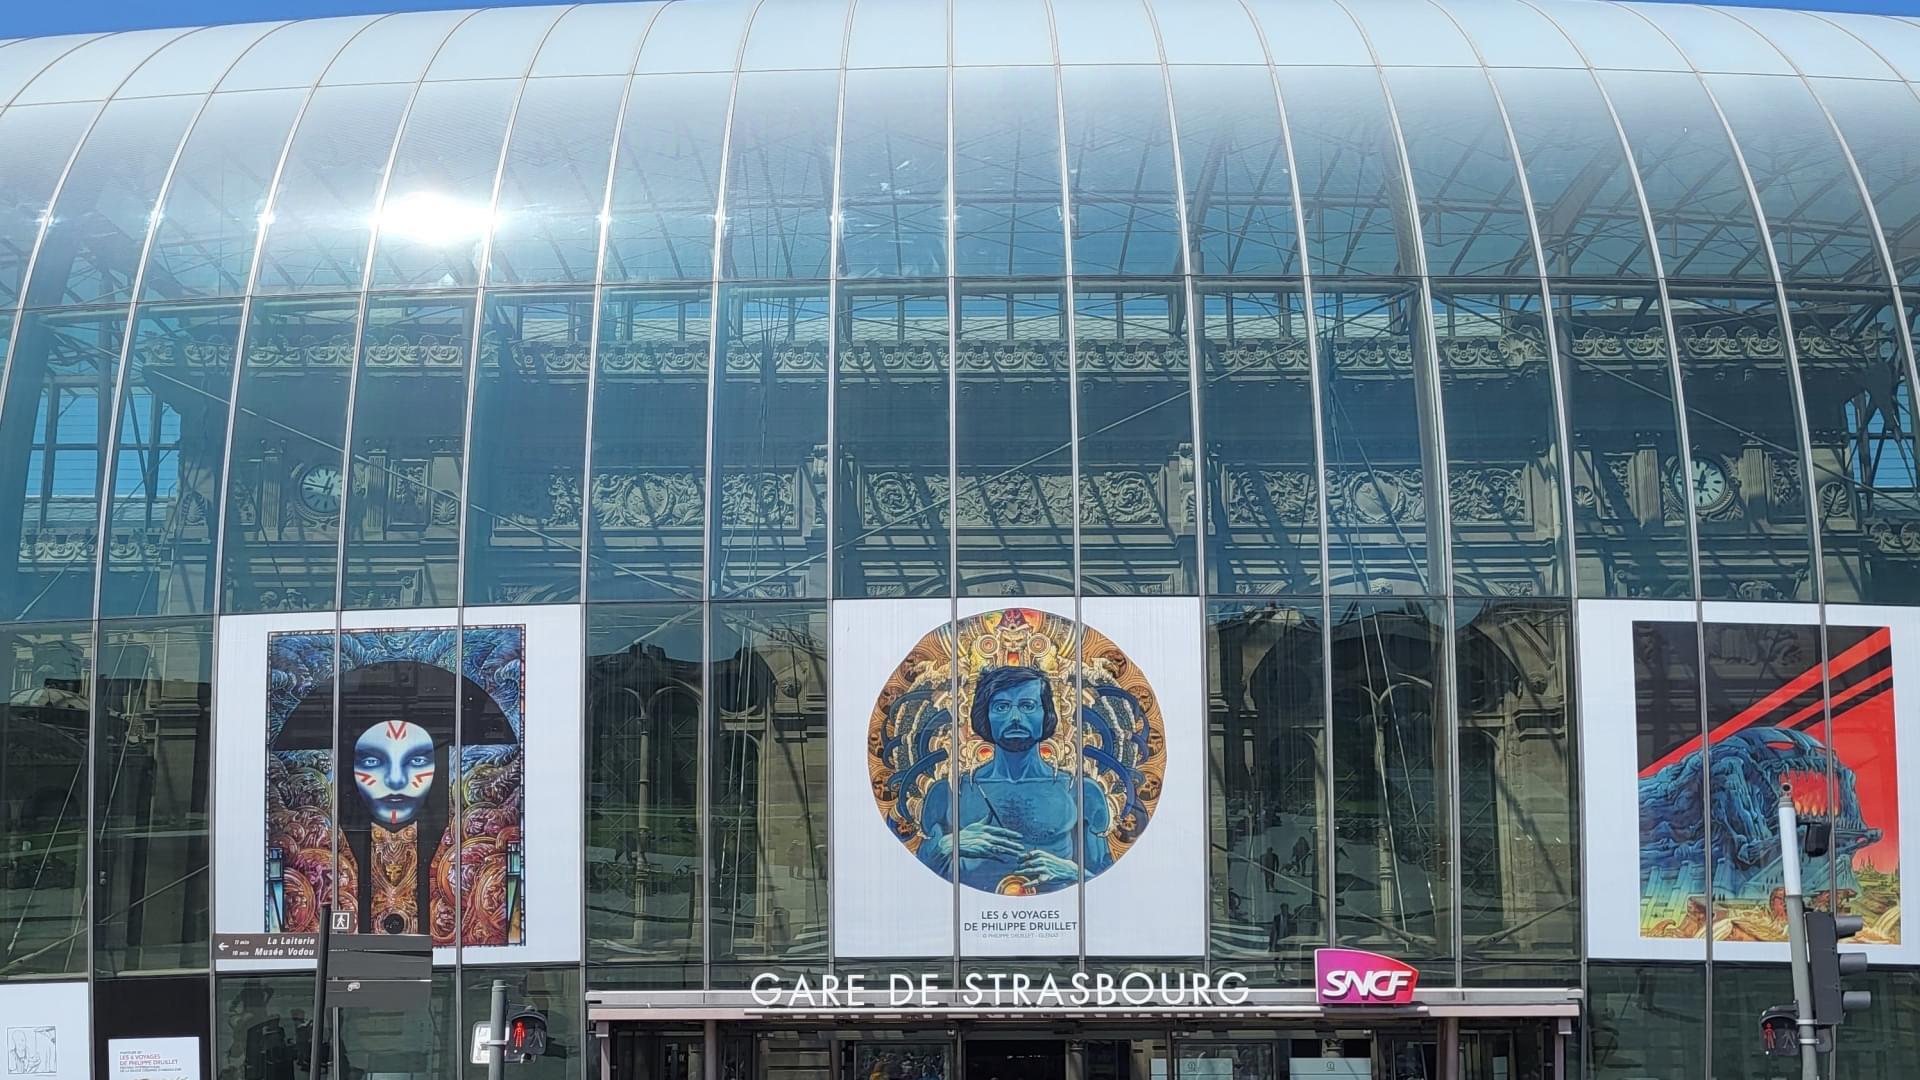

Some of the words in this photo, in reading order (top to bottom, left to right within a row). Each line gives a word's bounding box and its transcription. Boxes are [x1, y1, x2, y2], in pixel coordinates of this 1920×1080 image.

[981, 911, 999, 920] LES
[1001, 911, 1009, 920] 6
[1011, 910, 1060, 919] VOYAGES
[964, 922, 978, 931] DE
[981, 922, 1026, 931] PHILIPPE
[1029, 921, 1077, 931] DRUILLET
[267, 937, 278, 945] La
[281, 936, 316, 945] Laiterie
[254, 947, 284, 956] Musée
[287, 947, 315, 956] Vodou
[750, 972, 865, 1006] GARE
[890, 973, 938, 1006] DE
[962, 971, 1249, 1006] STRASBOURG
[1322, 970, 1413, 997] SNCF
